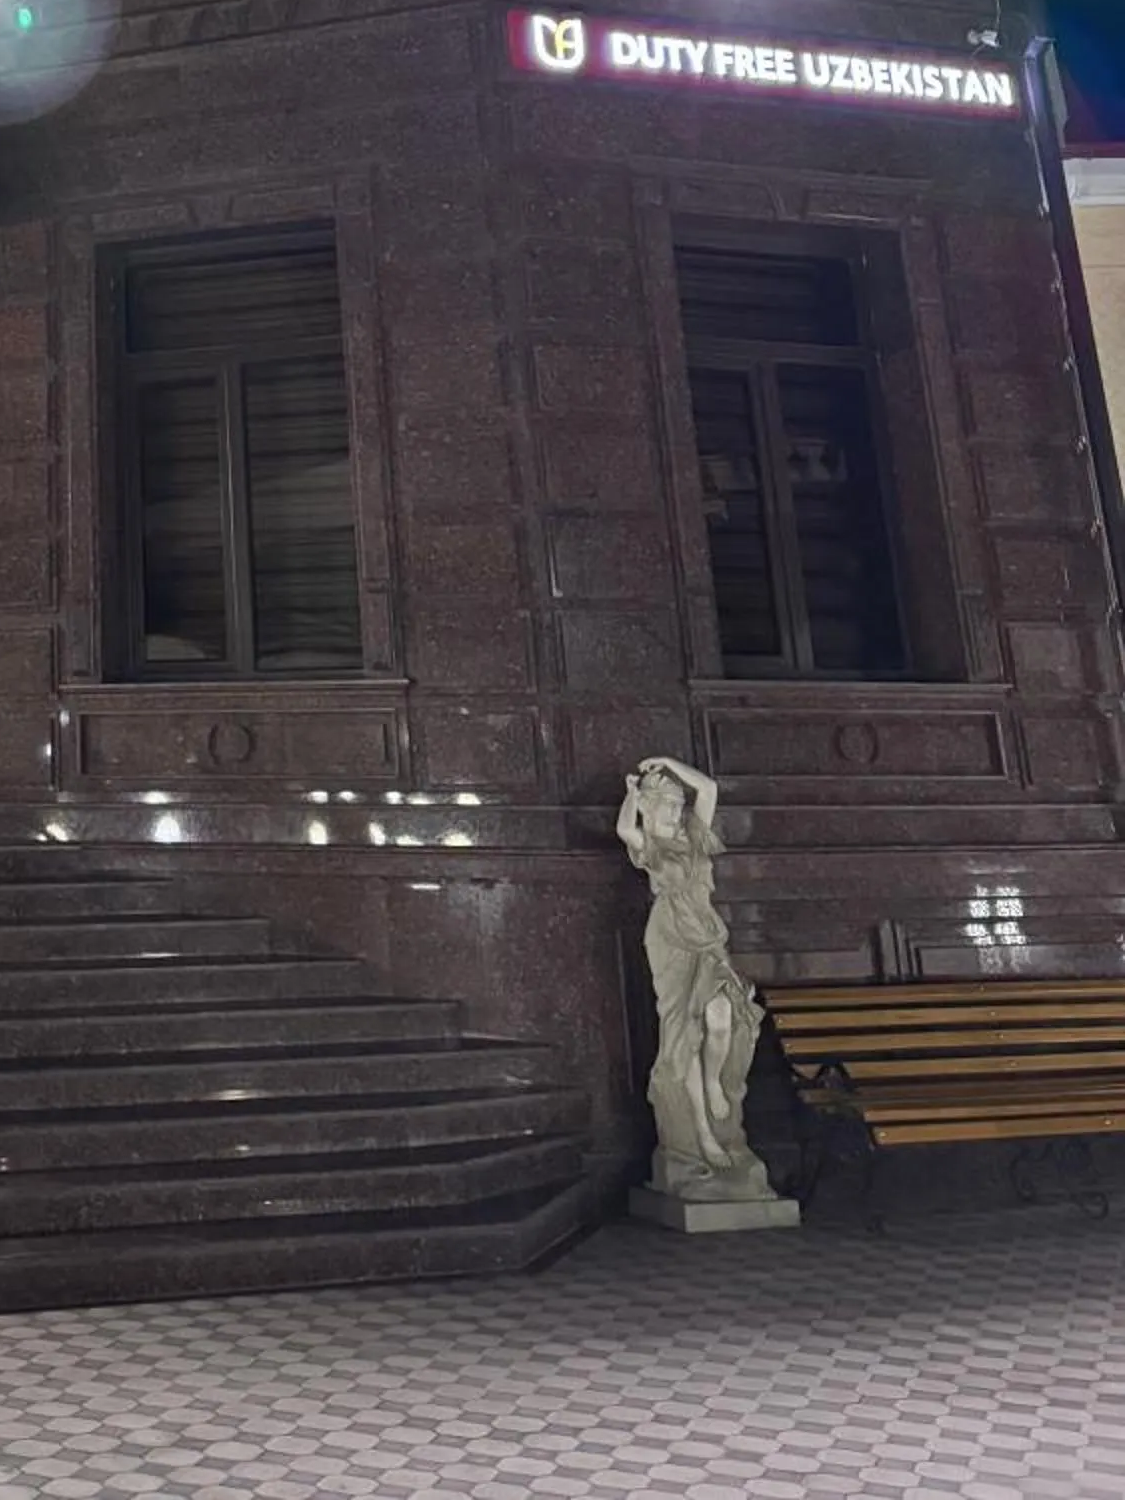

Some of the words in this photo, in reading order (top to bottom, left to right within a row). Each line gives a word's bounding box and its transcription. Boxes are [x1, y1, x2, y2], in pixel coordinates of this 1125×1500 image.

[611, 31, 707, 74] DUTY
[715, 43, 797, 83] FREE
[803, 53, 1014, 106] UZBEKISTAN
